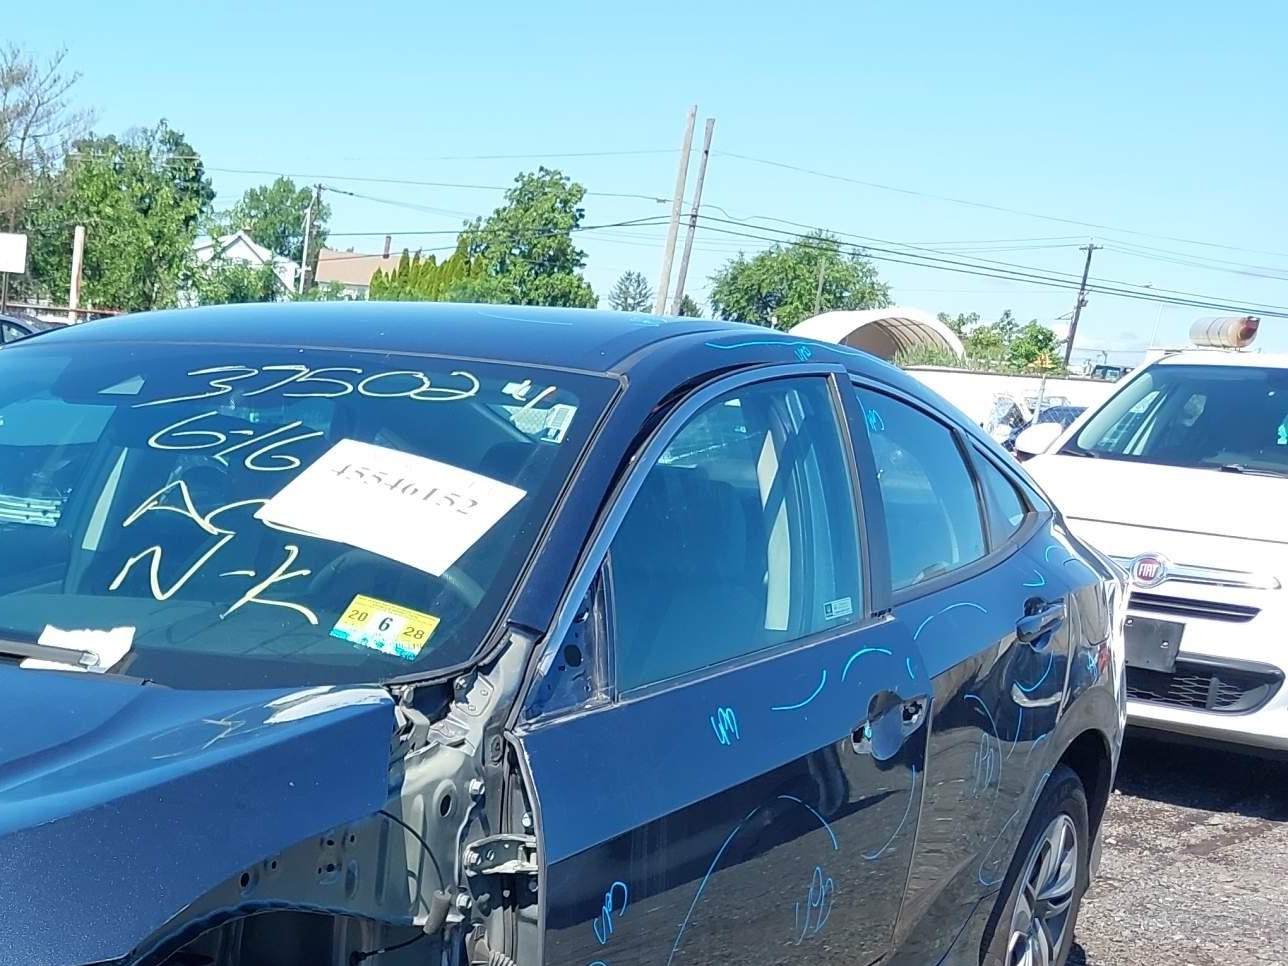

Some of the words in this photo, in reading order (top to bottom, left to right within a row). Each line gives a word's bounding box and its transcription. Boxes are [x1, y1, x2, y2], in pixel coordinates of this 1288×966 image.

[331, 463, 479, 516] 45546152
[1138, 562, 1160, 578] FIAT
[347, 609, 370, 623] 20
[378, 616, 394, 633] 6
[402, 626, 426, 641] 28
